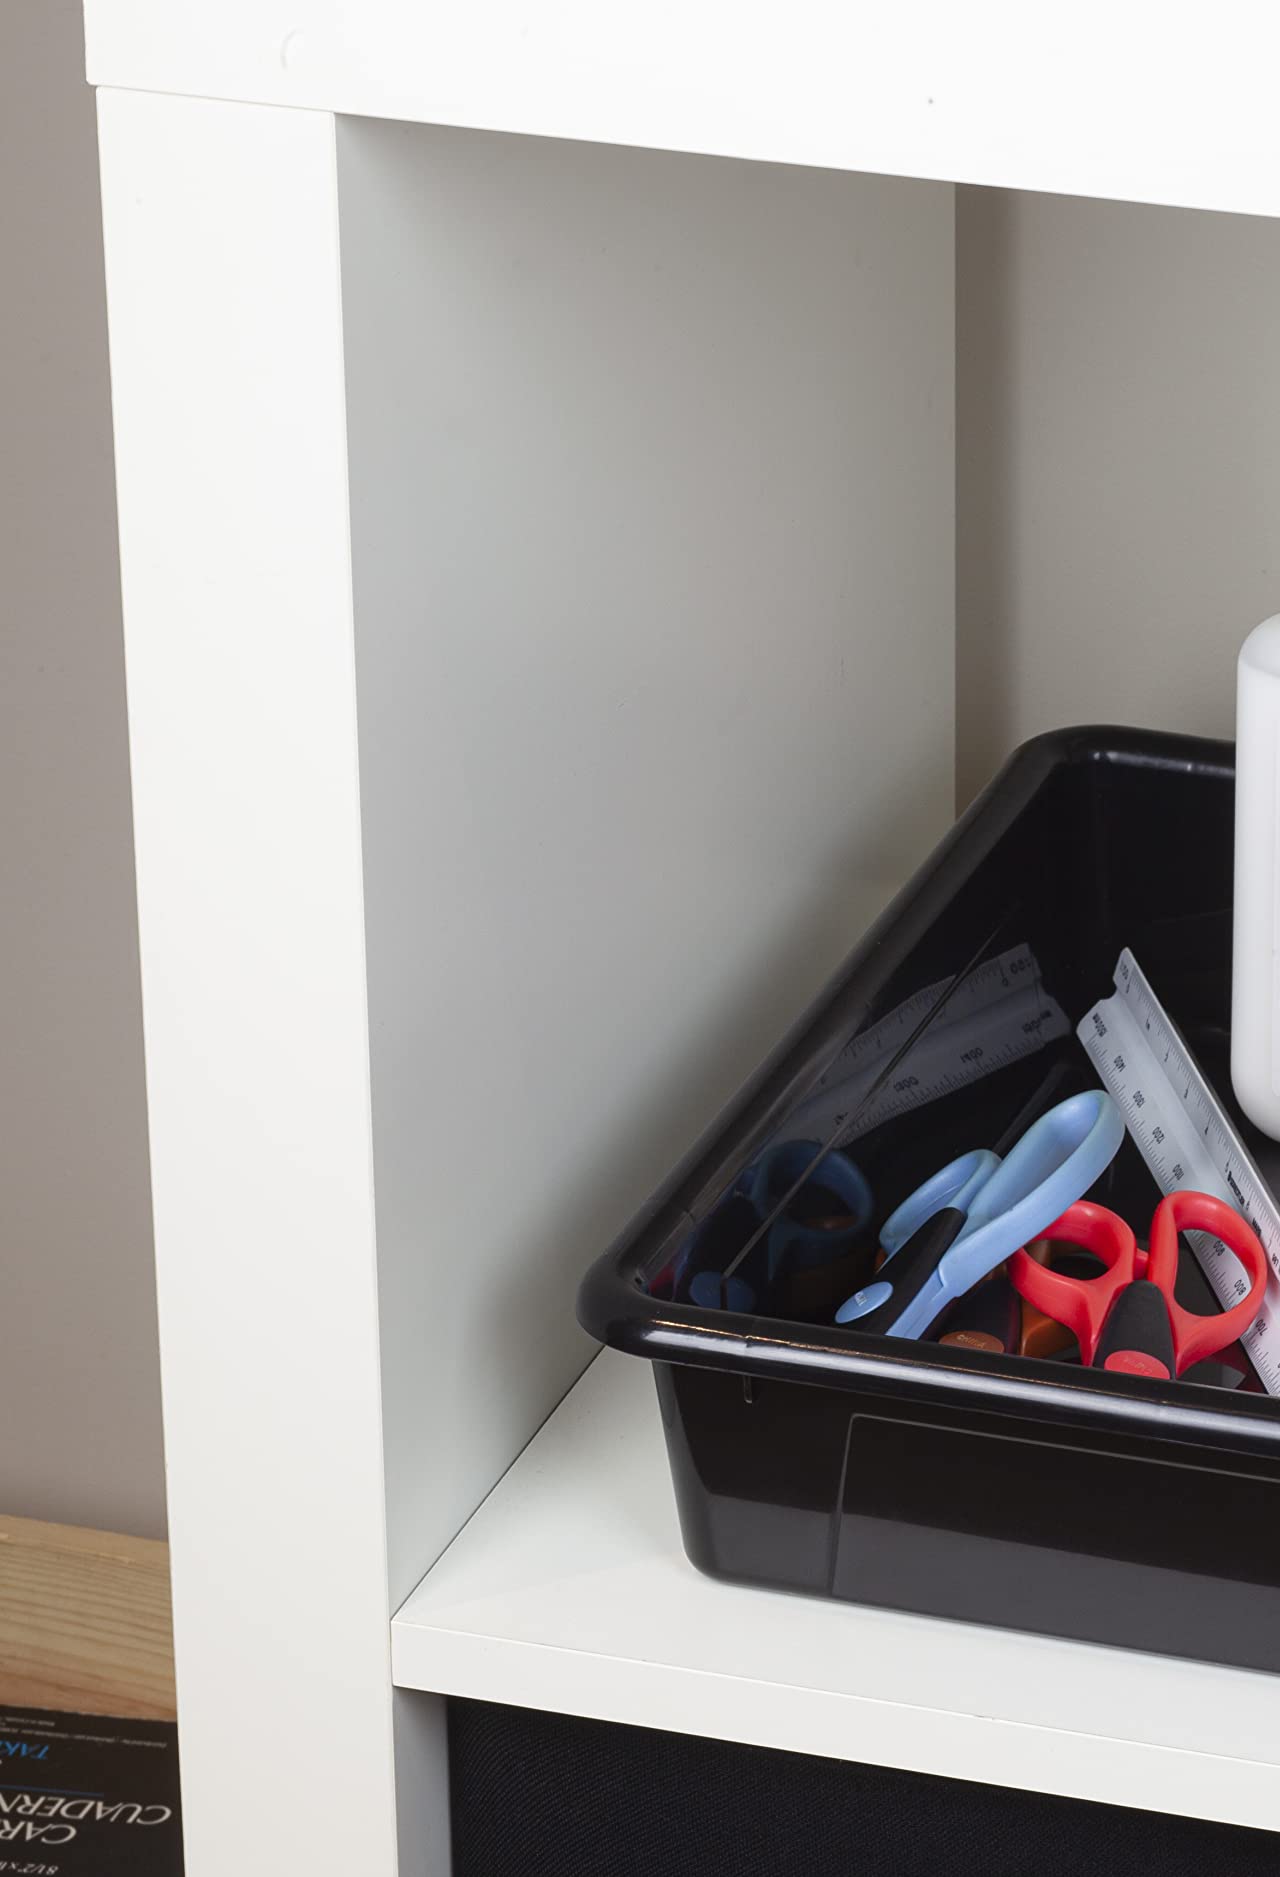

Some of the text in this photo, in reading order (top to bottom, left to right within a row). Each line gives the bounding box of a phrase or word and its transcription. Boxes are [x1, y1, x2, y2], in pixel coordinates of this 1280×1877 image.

[1133, 1090, 1144, 1108] 1300
[1152, 1126, 1165, 1144] 1200
[1173, 1164, 1184, 1180] 1100
[1213, 1240, 1225, 1256] 900
[1234, 1279, 1246, 1296] 800
[1256, 1319, 1267, 1336] 700
